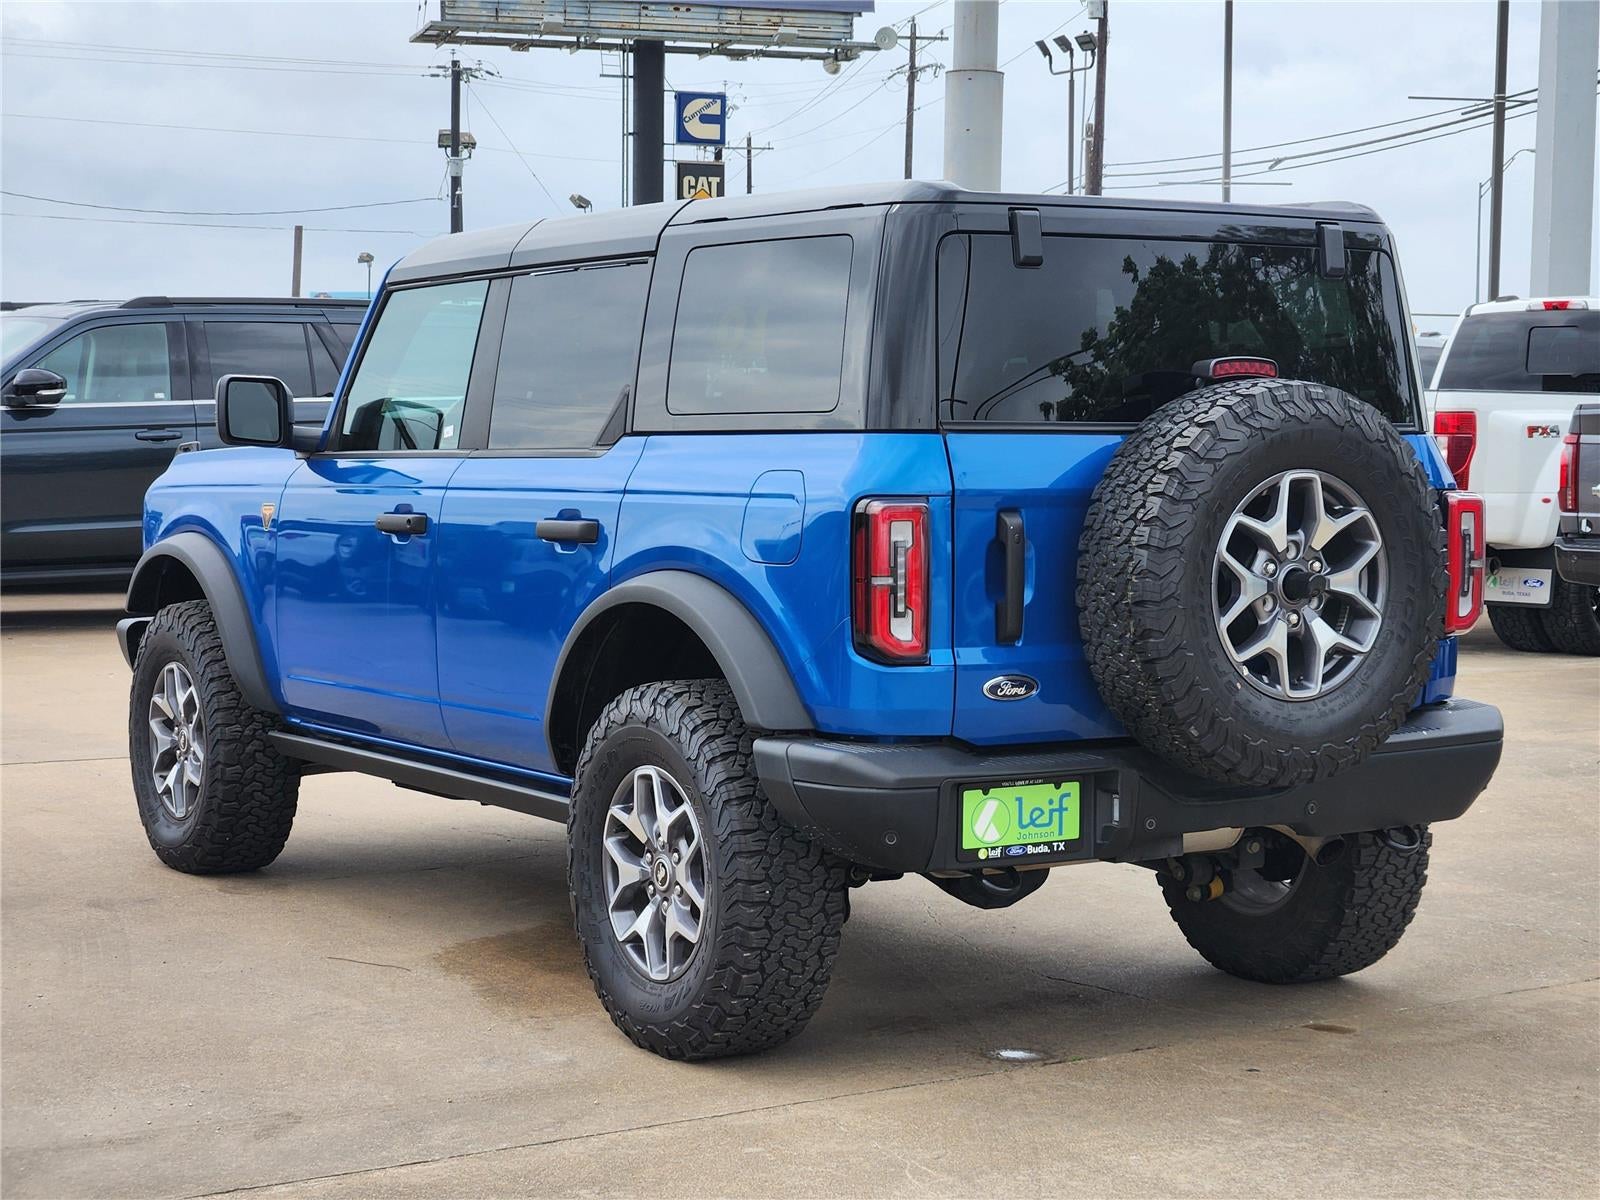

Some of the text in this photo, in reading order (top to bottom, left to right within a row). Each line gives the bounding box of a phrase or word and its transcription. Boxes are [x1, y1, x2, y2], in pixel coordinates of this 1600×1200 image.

[683, 99, 719, 124] Cummins
[682, 175, 720, 198] CAT
[1527, 424, 1560, 439] FX4
[997, 680, 1027, 696] Ford
[1015, 792, 1072, 836] leif
[1017, 830, 1055, 841] Johnson
[1027, 844, 1051, 854] Buda,
[1052, 841, 1066, 852] TX
